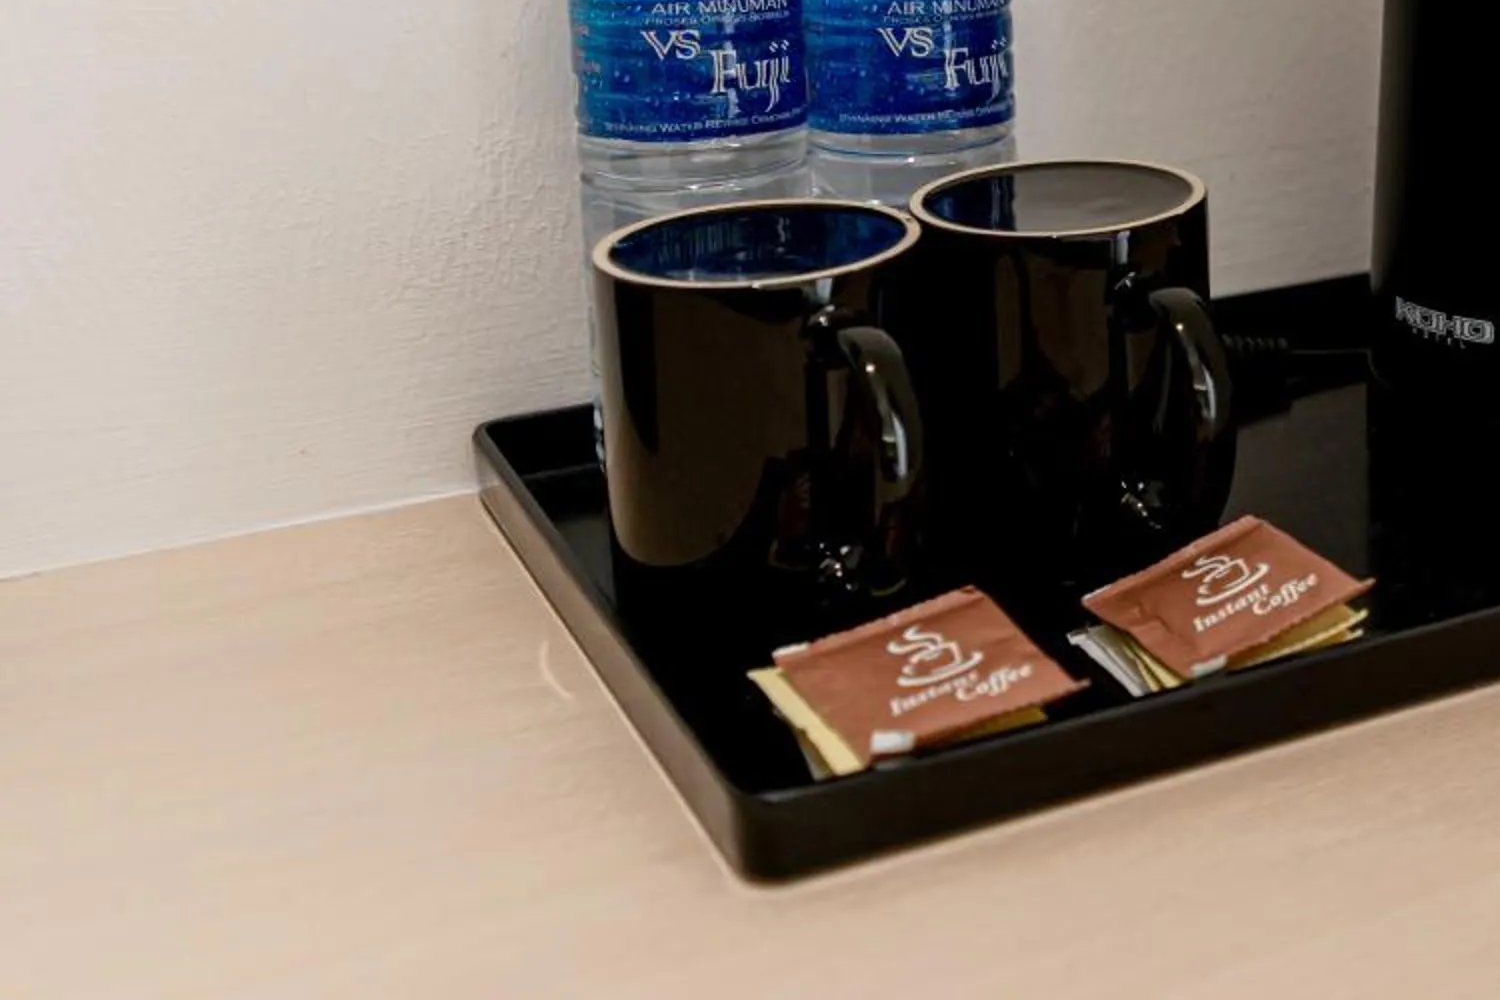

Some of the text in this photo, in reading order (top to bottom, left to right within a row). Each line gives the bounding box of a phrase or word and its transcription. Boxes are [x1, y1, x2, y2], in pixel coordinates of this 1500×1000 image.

[651, 1, 691, 16] AIR
[887, 0, 925, 16] AIR
[640, 28, 701, 61] VS
[876, 26, 935, 58] VS
[708, 40, 793, 113] Fuji
[1193, 583, 1270, 632] Instant
[1252, 573, 1319, 615] Coffee
[889, 669, 978, 718] Instant
[954, 663, 1033, 702] Coffee
